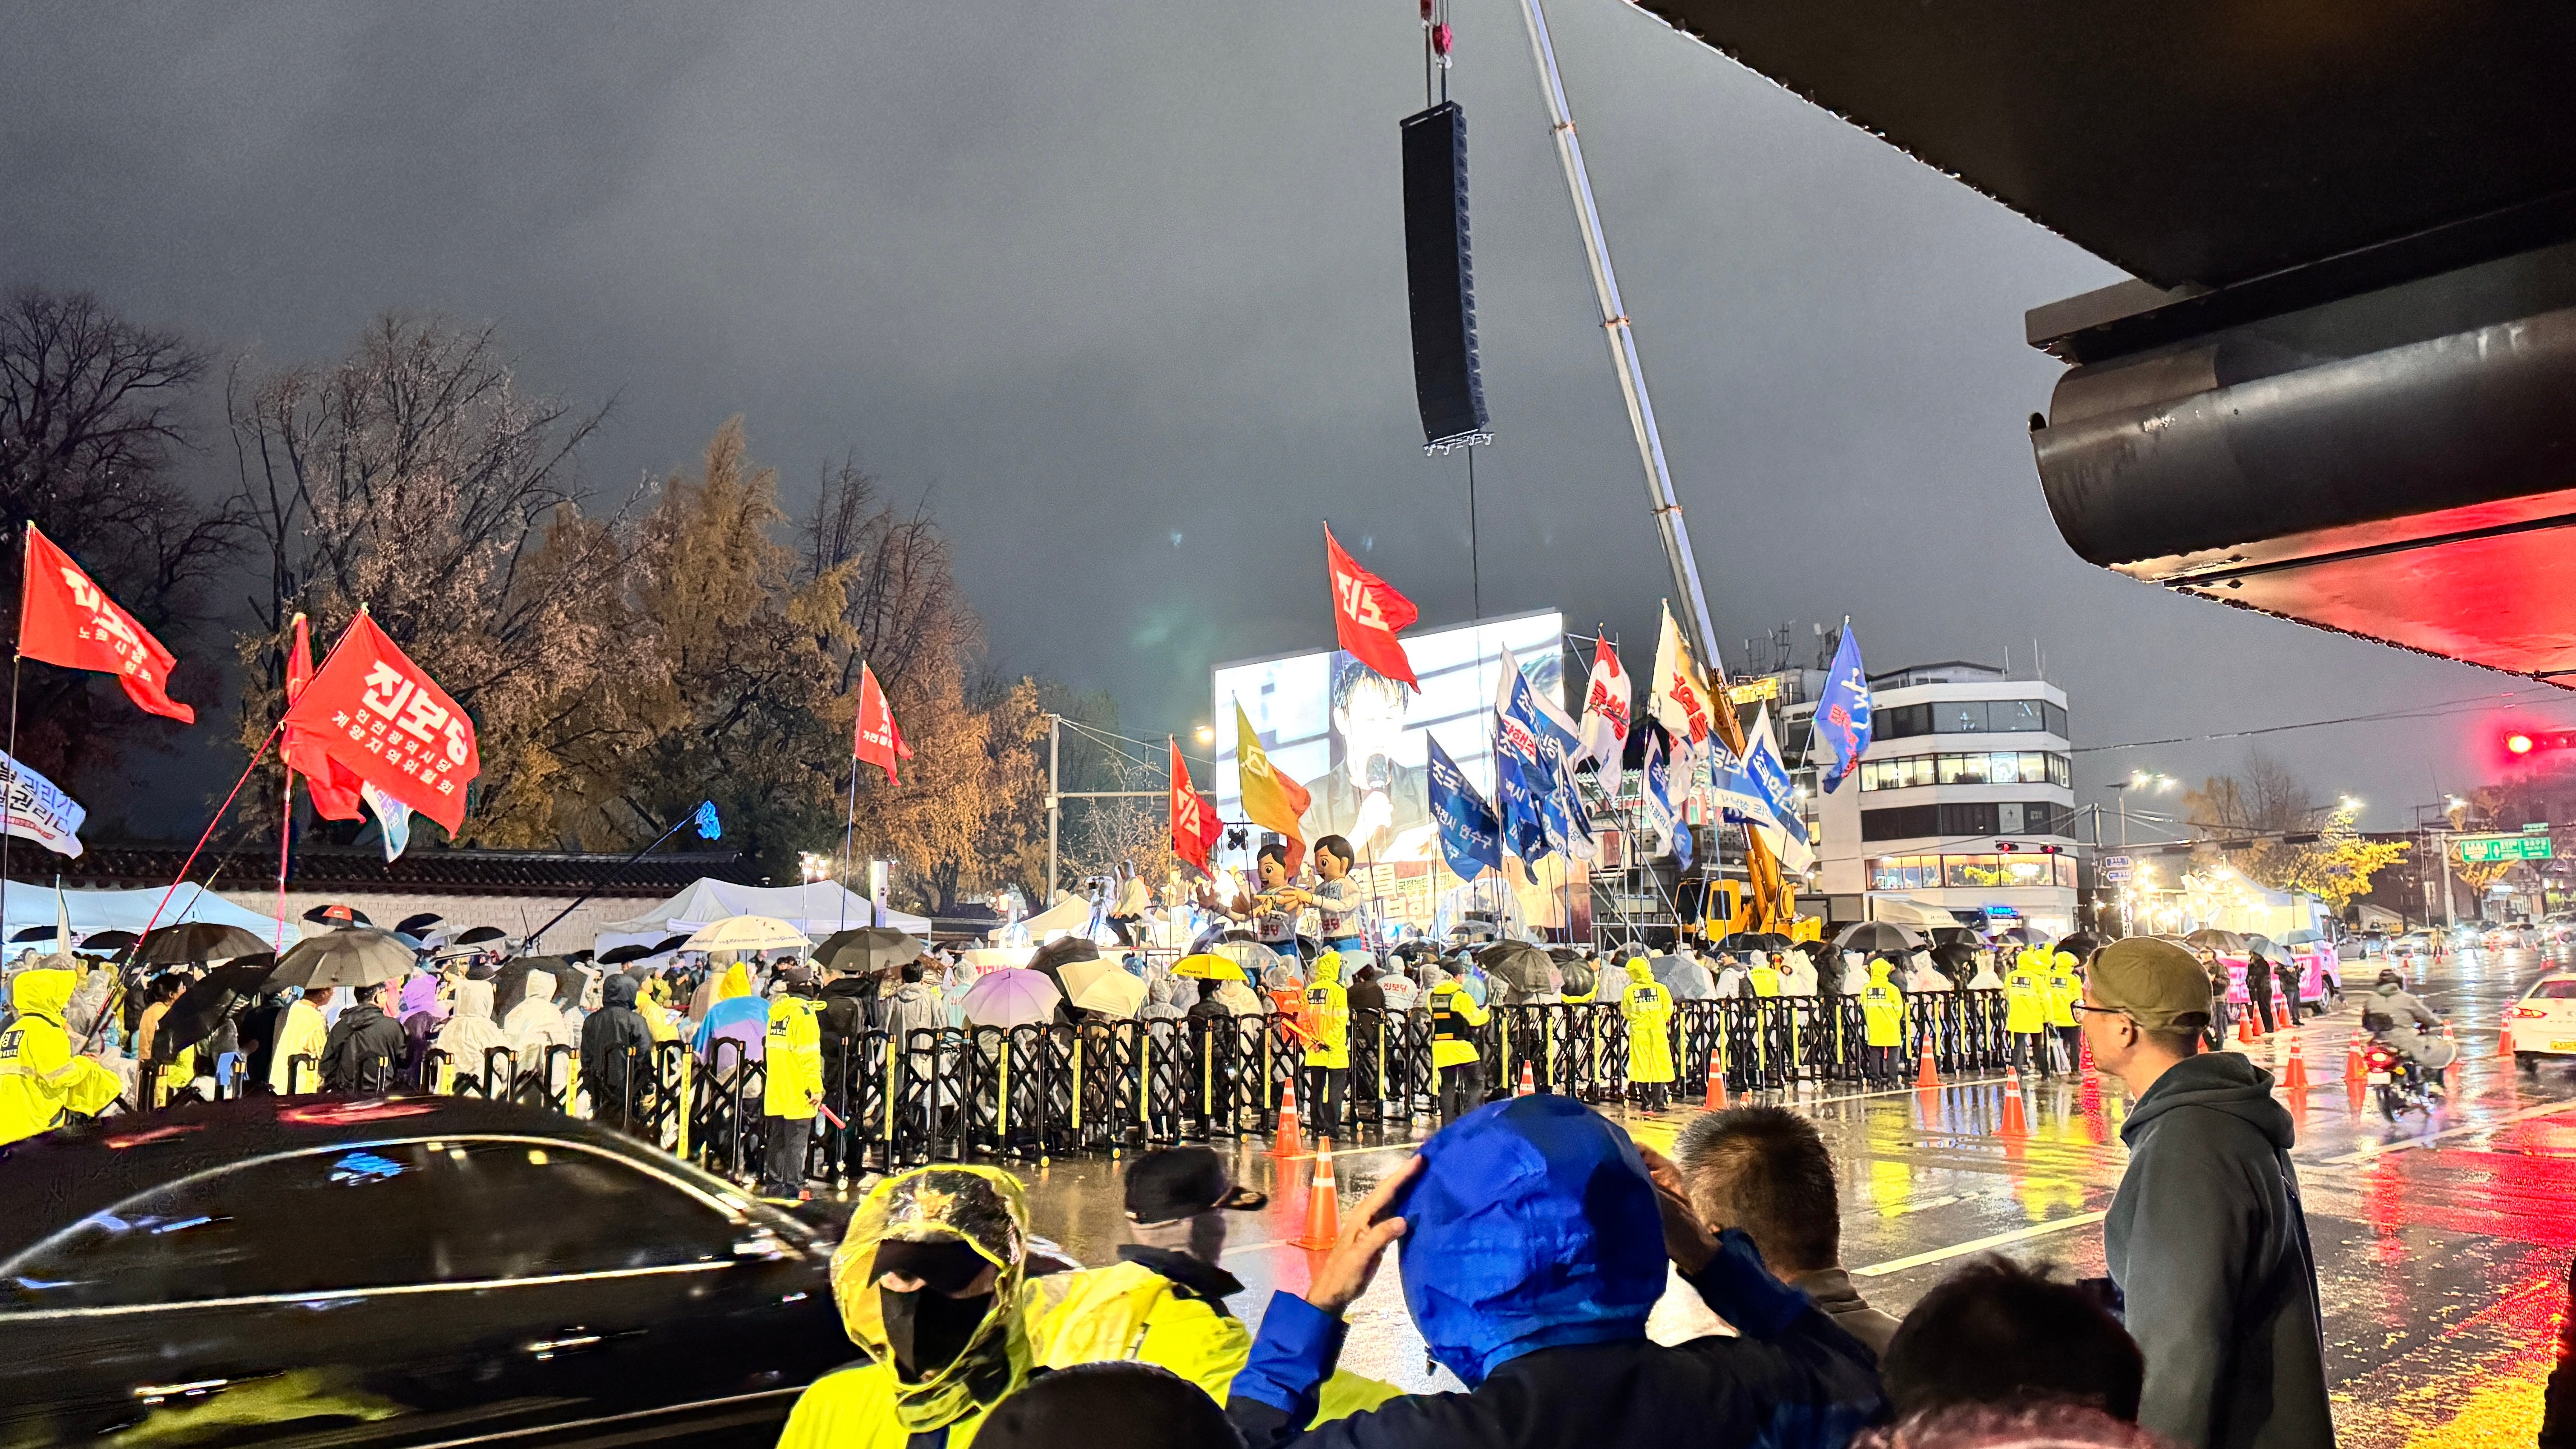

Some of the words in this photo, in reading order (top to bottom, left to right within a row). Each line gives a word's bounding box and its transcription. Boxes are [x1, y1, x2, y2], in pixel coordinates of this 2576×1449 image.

[356, 708, 452, 773] 인천광역시당
[362, 660, 468, 766] 진보당
[331, 710, 455, 796] 계양지역위원회
[1459, 824, 1493, 850] 연수구
[1384, 983, 1407, 993] 진보당
